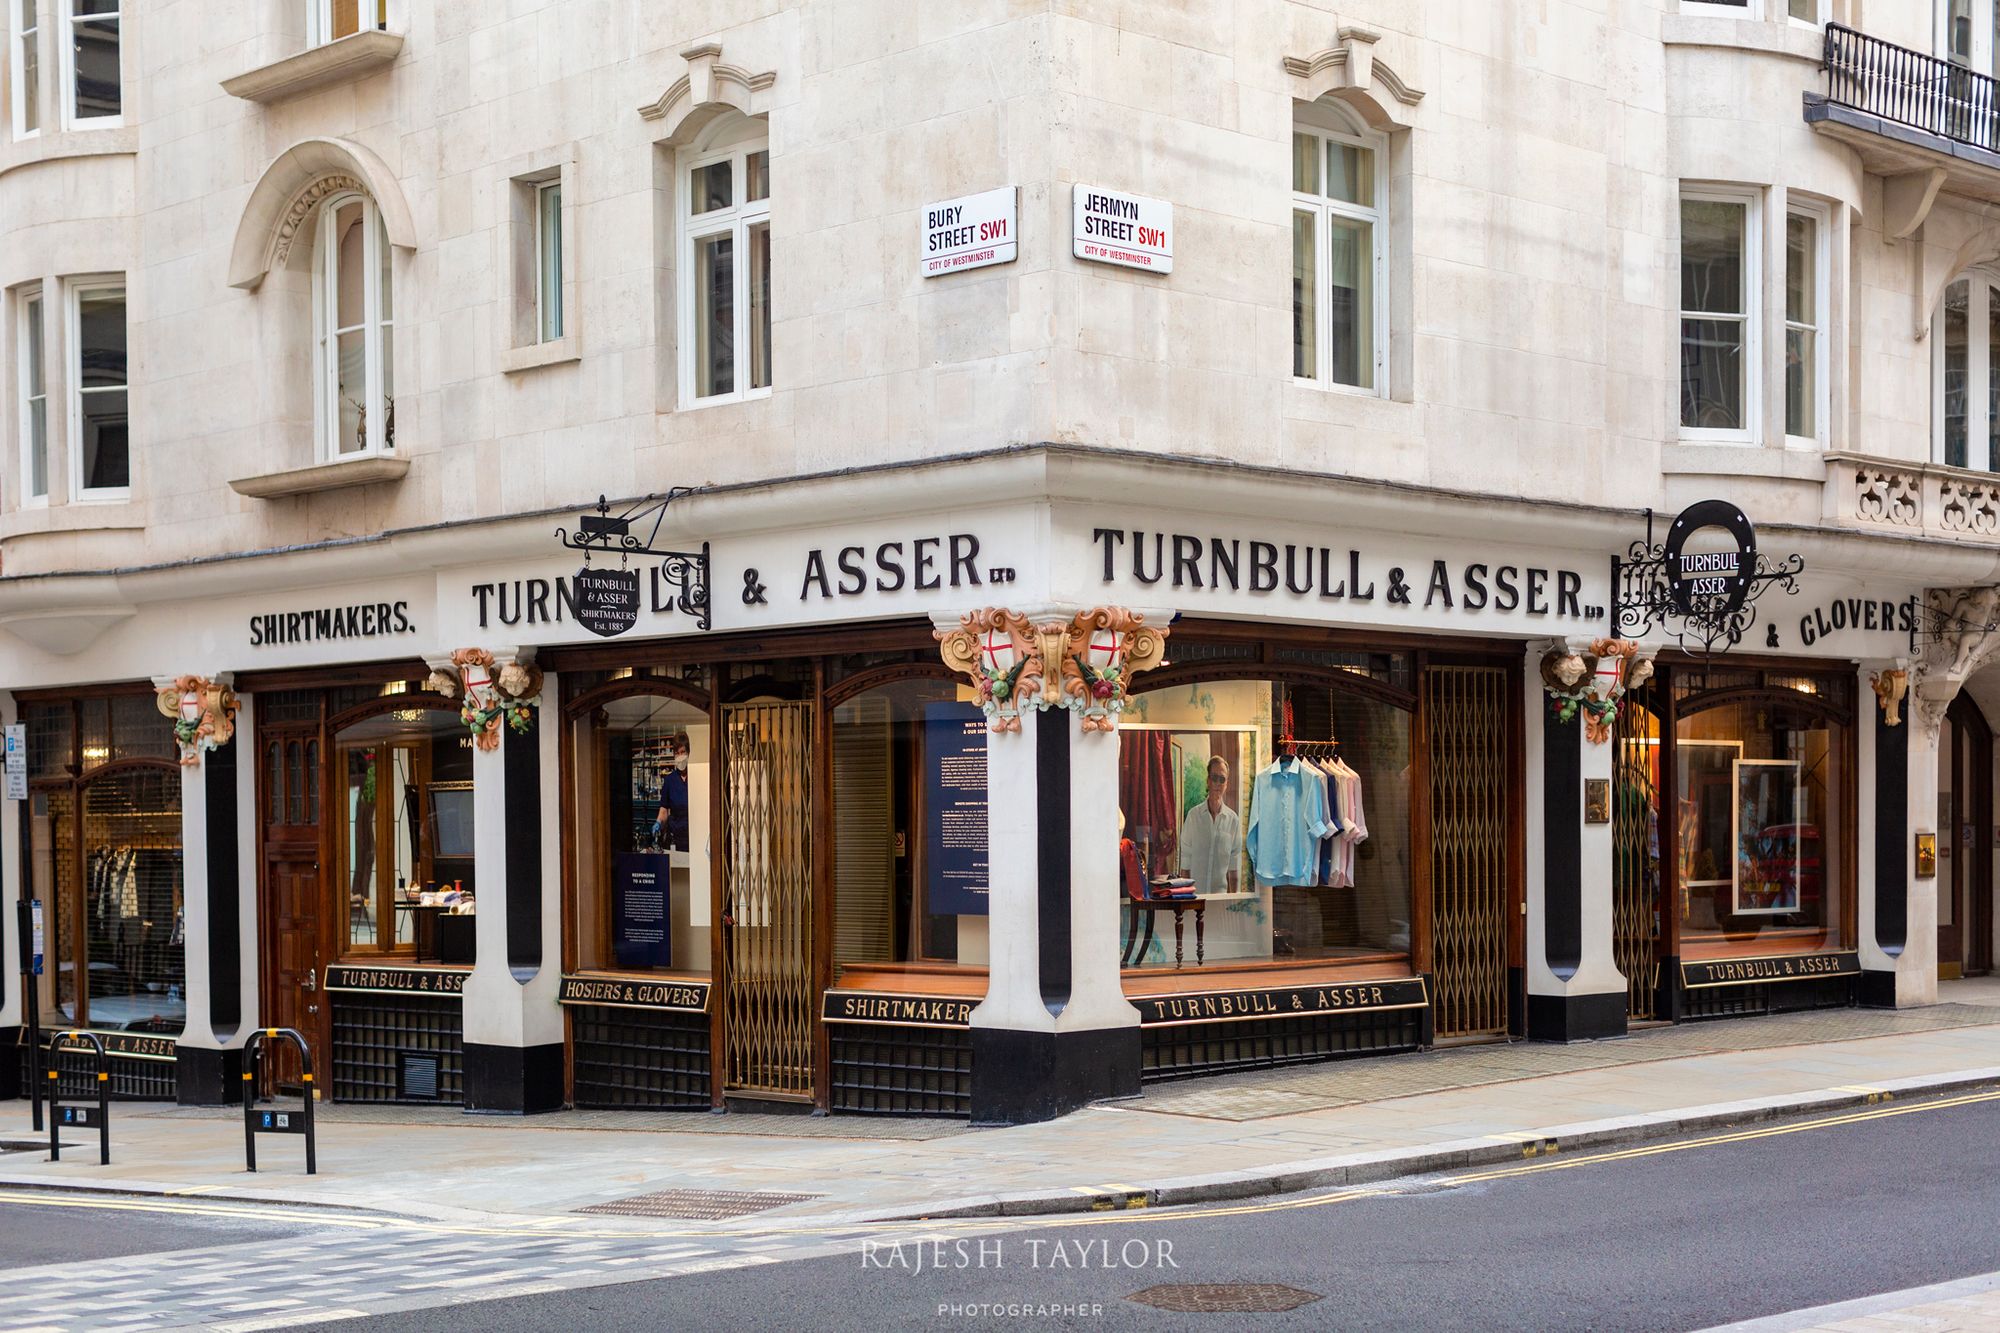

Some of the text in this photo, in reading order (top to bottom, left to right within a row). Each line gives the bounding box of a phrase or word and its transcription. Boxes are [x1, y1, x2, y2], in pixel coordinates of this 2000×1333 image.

[928, 205, 963, 230] BURY
[1085, 193, 1139, 221] JERMYN
[929, 218, 1007, 252] STREET SW1
[1085, 215, 1165, 249] STREET SW1
[929, 249, 995, 271] CITY OF WESTMINSTER
[1084, 245, 1152, 266] CITY OF WESTMINSTER
[742, 568, 768, 605] &
[800, 534, 983, 601] ASSER
[1093, 528, 1374, 601] TURNBULL
[1387, 567, 1412, 605] &
[1424, 560, 1581, 618] ASSER
[1680, 552, 1740, 573] TURNBULL
[581, 577, 636, 592] TURNBULL
[1691, 577, 1726, 595] ASSER
[587, 592, 628, 604] & ASSER
[250, 601, 416, 646] SHIRTMAKERS.
[581, 609, 636, 620] SHIRTMAKERS
[608, 622, 624, 631] 1885
[1766, 623, 1779, 648] &
[342, 970, 414, 989] TURNBULL
[419, 976, 428, 990] &
[1707, 957, 1840, 981] TURNBULL & ASSER
[566, 981, 700, 1006] HOSIERS & GLOVERS
[1154, 987, 1384, 1020] TURNBULL & ASSER
[133, 1039, 175, 1056] ASSER
